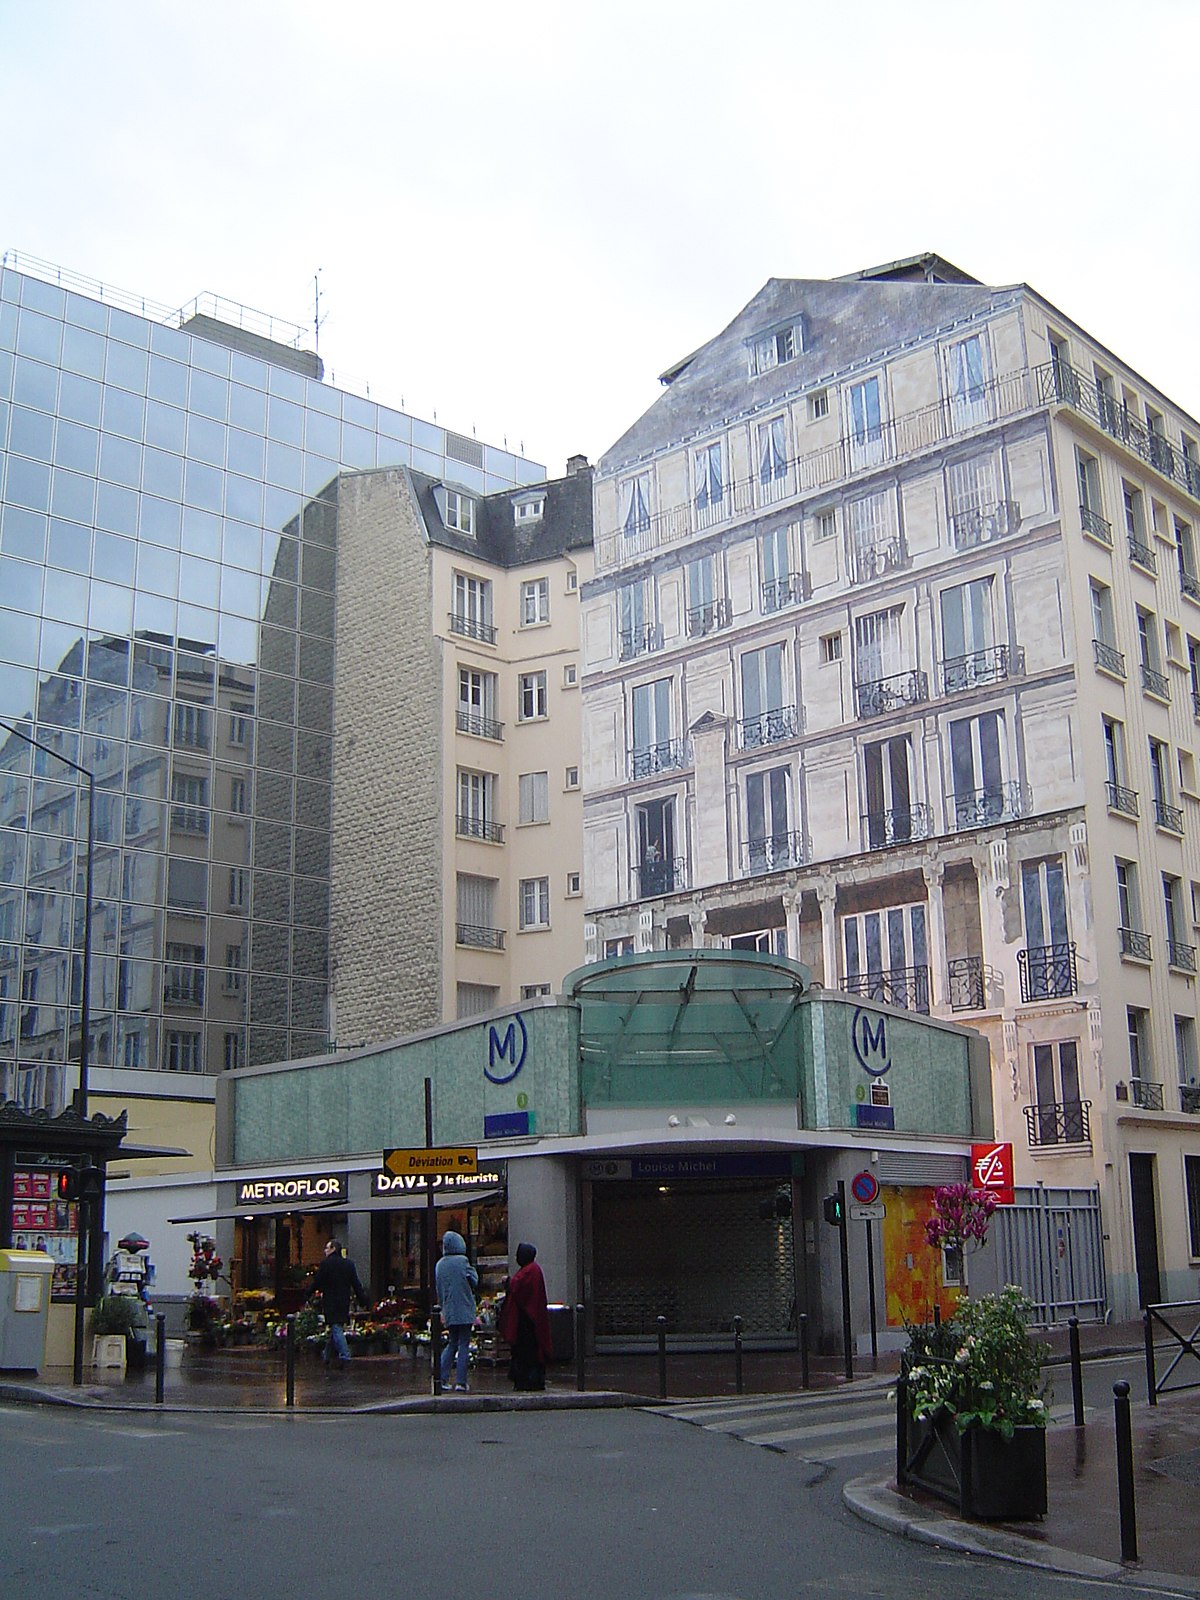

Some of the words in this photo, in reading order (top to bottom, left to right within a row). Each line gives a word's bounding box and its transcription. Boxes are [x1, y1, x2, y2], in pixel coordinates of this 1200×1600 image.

[862, 1015, 886, 1058] M
[489, 1023, 515, 1067] M
[408, 1156, 453, 1167] Déviation
[638, 1162, 674, 1172] Louise
[679, 1161, 716, 1171] Michel
[445, 1175, 455, 1185] le
[456, 1173, 499, 1184] fleuriste
[241, 1178, 340, 1199] METROFLOR
